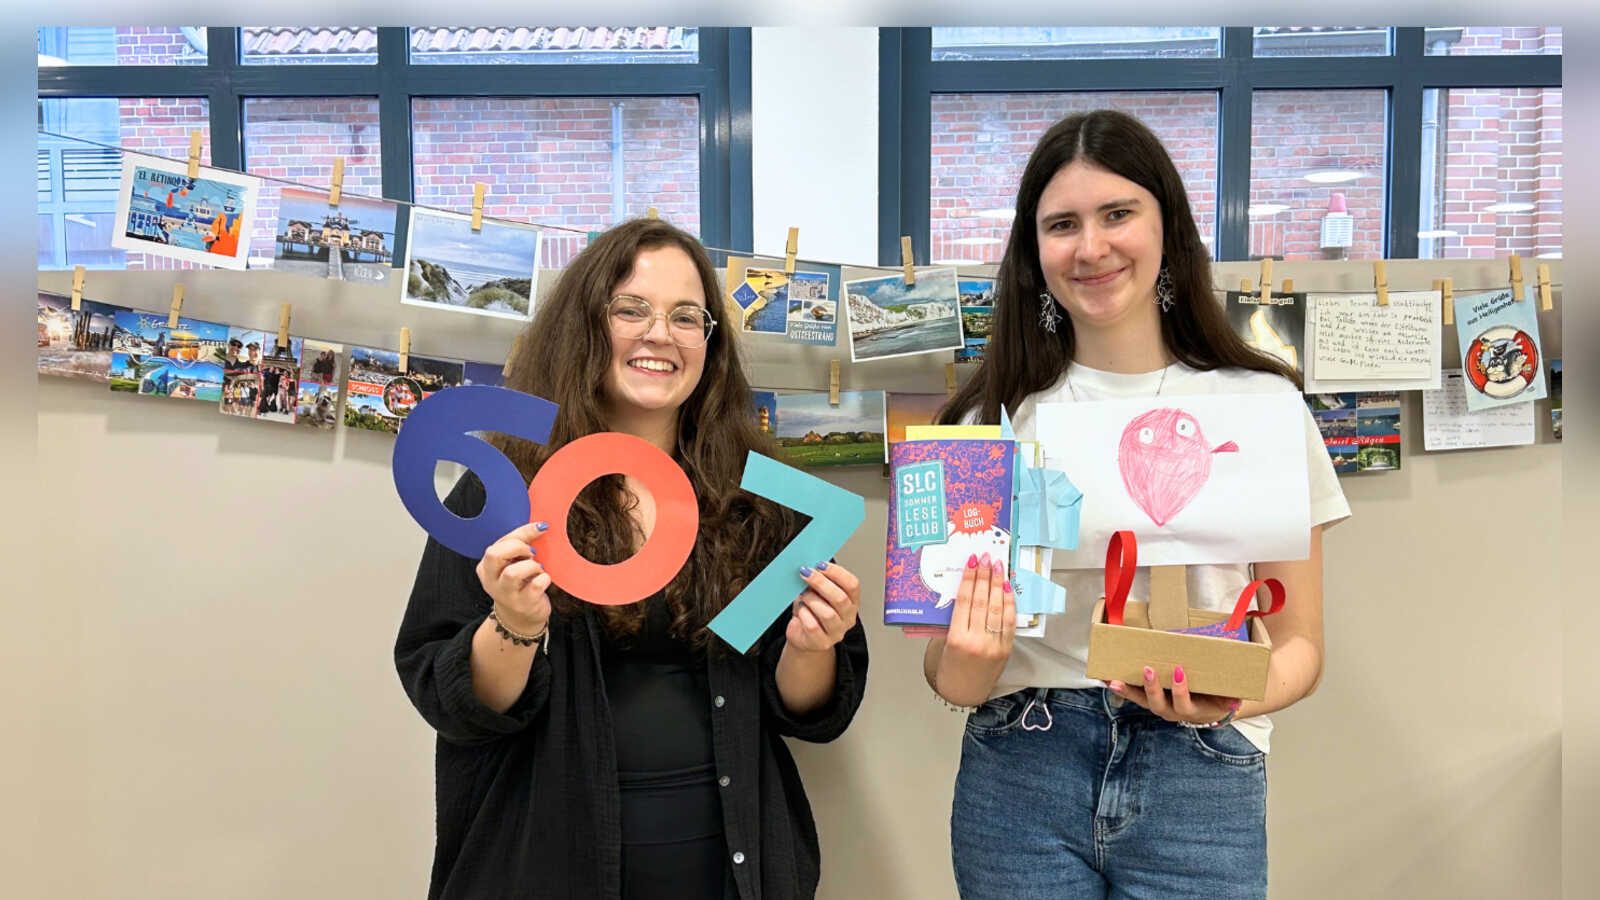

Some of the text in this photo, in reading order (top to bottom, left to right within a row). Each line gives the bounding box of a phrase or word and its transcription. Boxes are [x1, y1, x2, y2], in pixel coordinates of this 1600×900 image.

[903, 470, 937, 495] SLC
[904, 495, 937, 507] SOMMER
[905, 506, 938, 522] LESE
[905, 521, 939, 538] CLUB
[964, 517, 985, 529] BUCH
